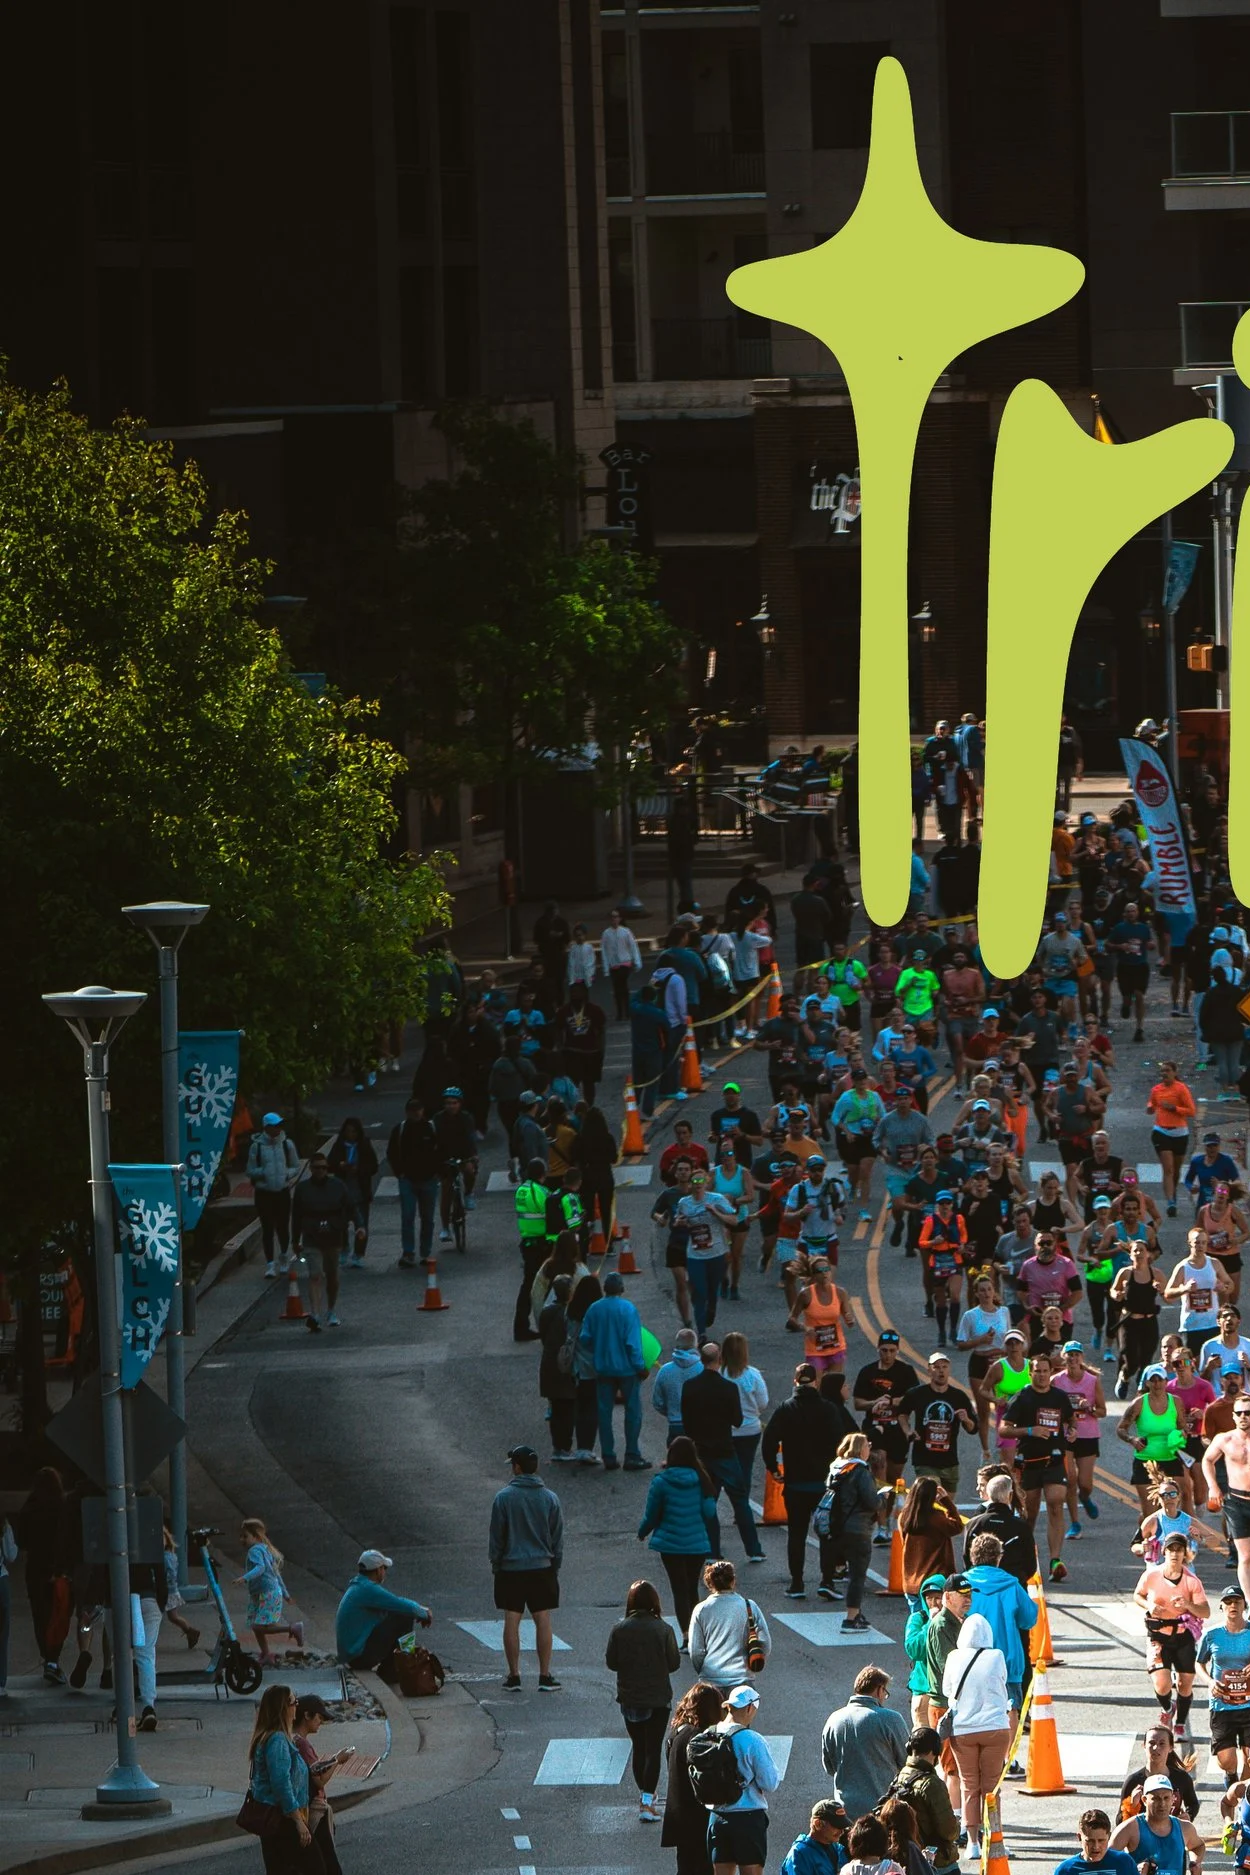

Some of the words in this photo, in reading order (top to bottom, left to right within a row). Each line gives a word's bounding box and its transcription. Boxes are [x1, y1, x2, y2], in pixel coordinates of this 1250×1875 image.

[610, 448, 650, 466] Bar
[1156, 822, 1189, 906] RUMBLE
[183, 1067, 206, 1198] GULCH
[125, 1204, 151, 1352] GULCH
